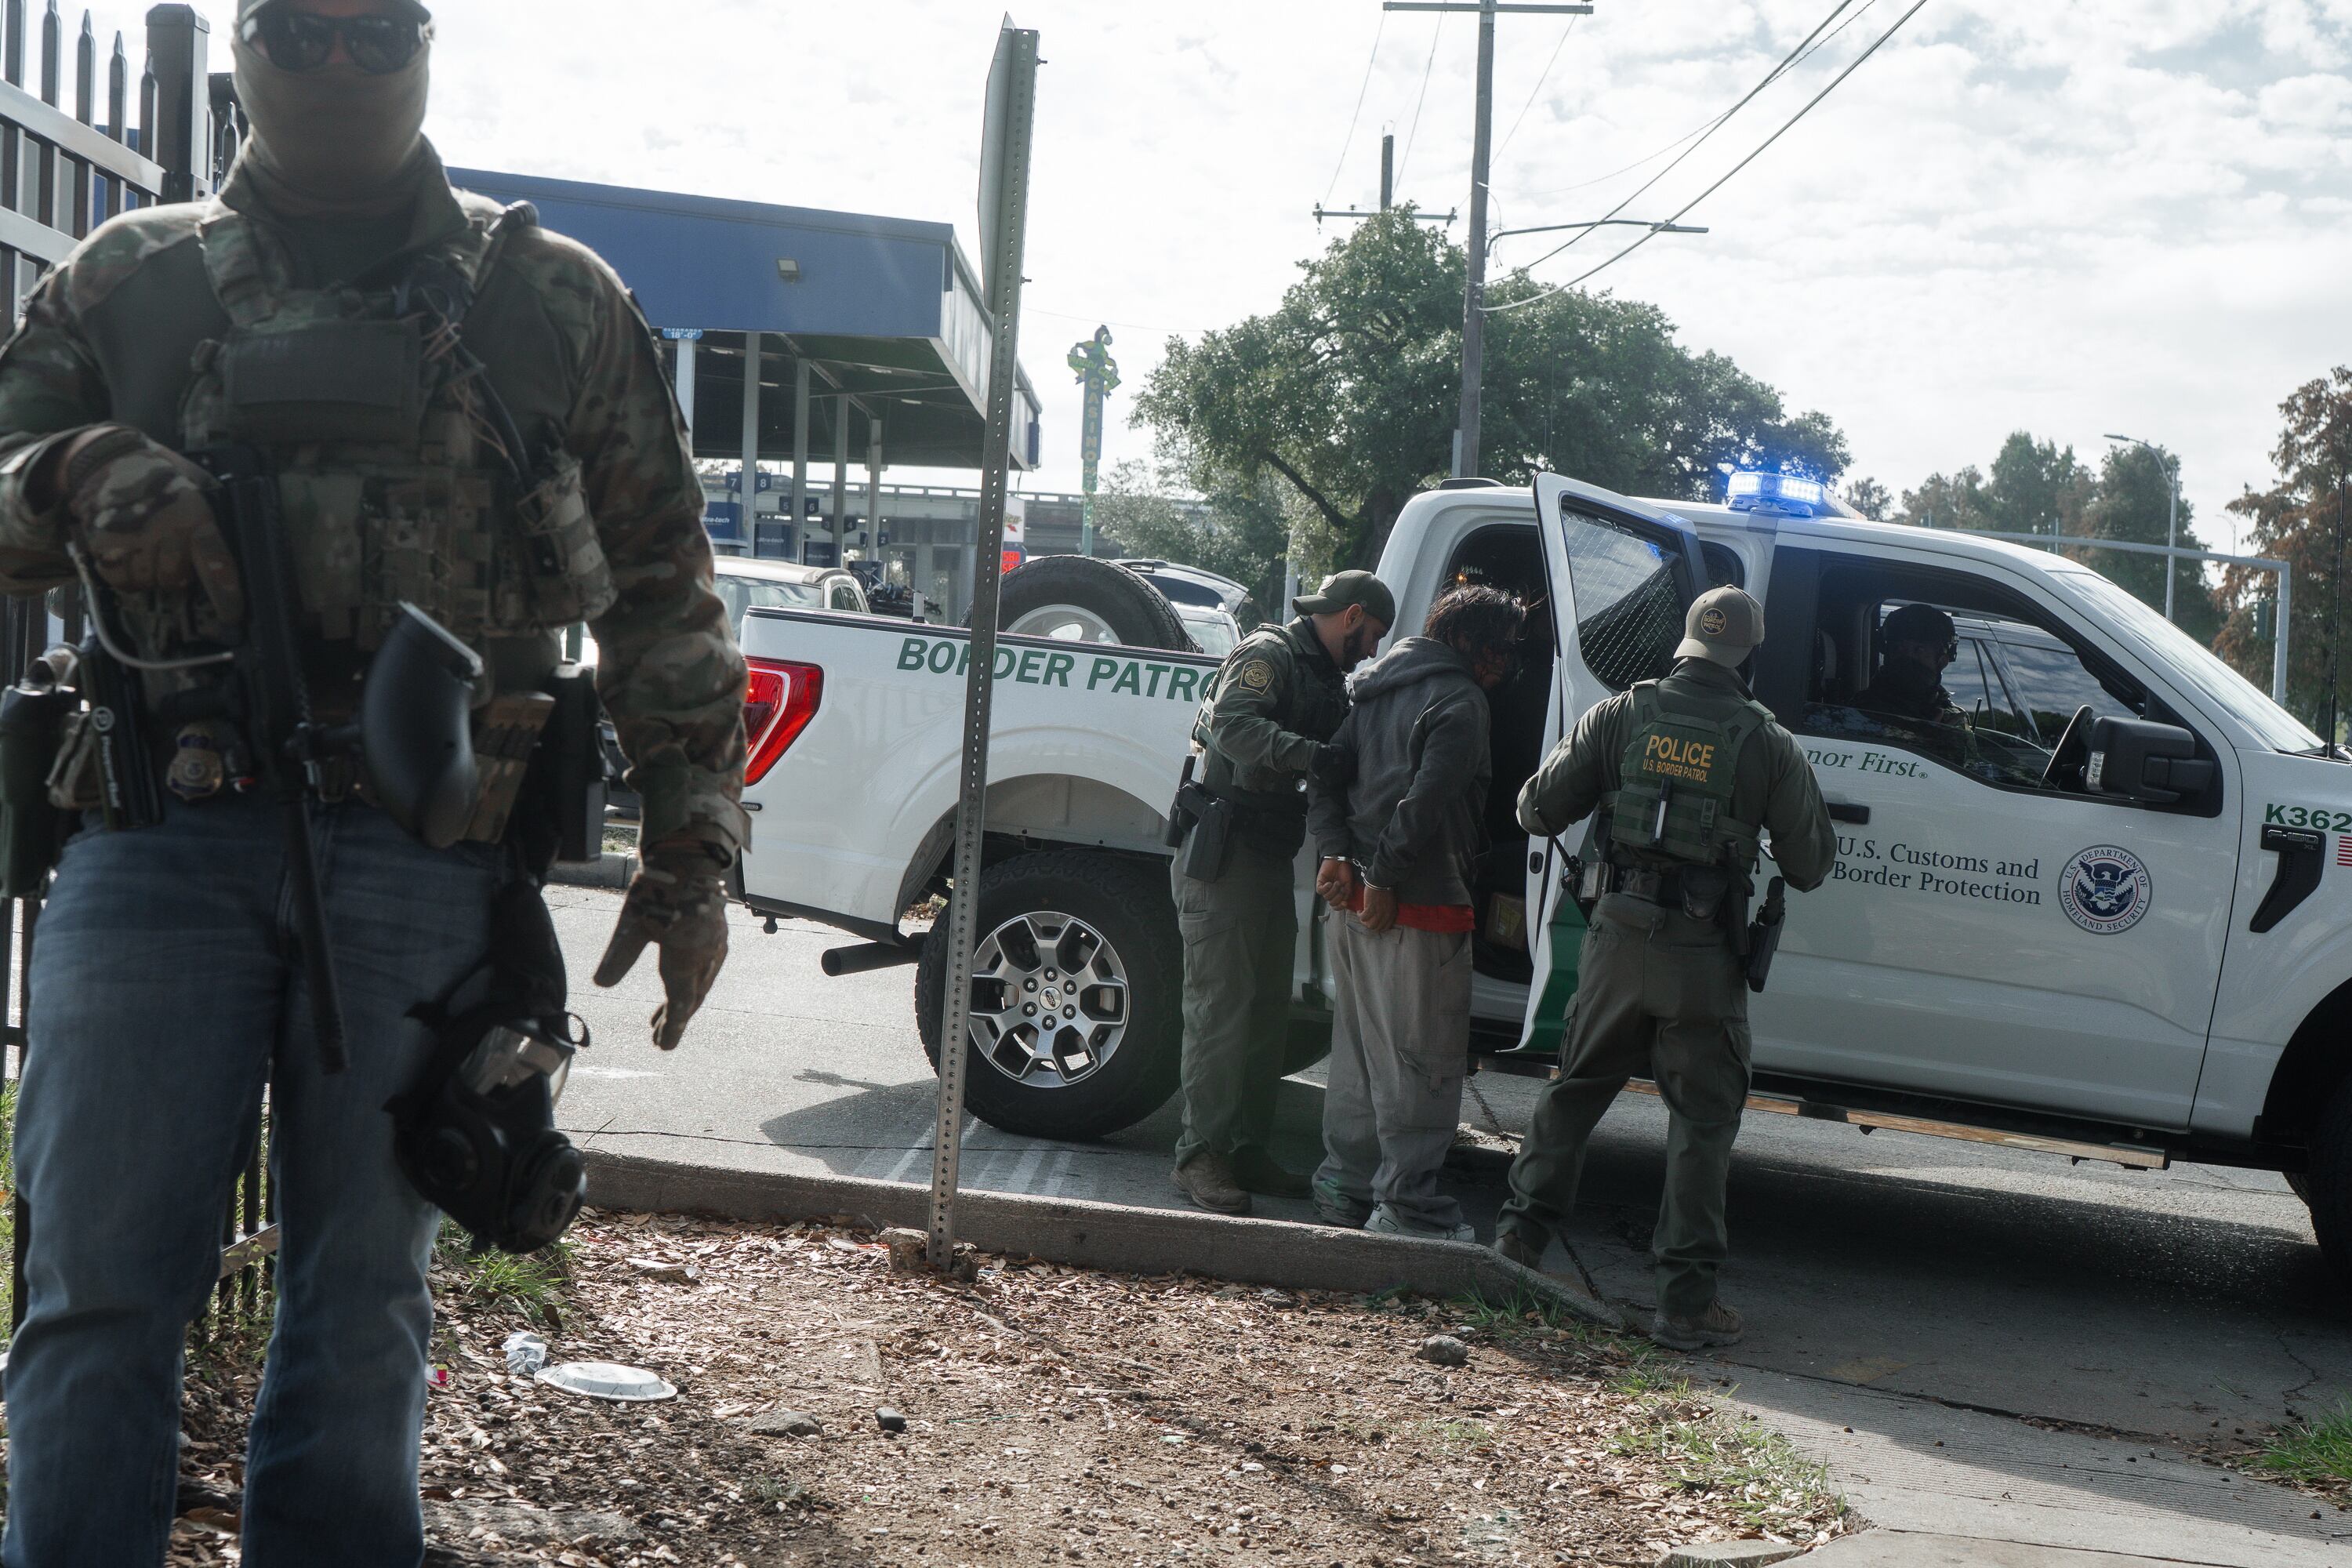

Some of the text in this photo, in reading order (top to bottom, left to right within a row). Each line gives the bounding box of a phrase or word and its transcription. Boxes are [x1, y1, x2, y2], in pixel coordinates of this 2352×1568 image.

[1085, 376, 1099, 463] CASINO
[731, 478, 737, 487] 7
[760, 478, 767, 488] 8
[783, 502, 789, 510] 5
[809, 503, 815, 511] 6
[1087, 657, 1220, 702] PATR
[1646, 735, 1715, 768] POLICE
[1807, 750, 1853, 768] nor
[1642, 758, 1708, 782] U.S. BORDER PATROL
[2265, 803, 2352, 833] K362
[2268, 829, 2318, 844] F-150
[1837, 836, 2039, 880] U.S. Customs and
[2065, 849, 2148, 888] U.S. DEPARTMENT OF
[1831, 860, 2042, 906] Border Protection
[2063, 890, 2147, 931] HOMELAND SECURITY
